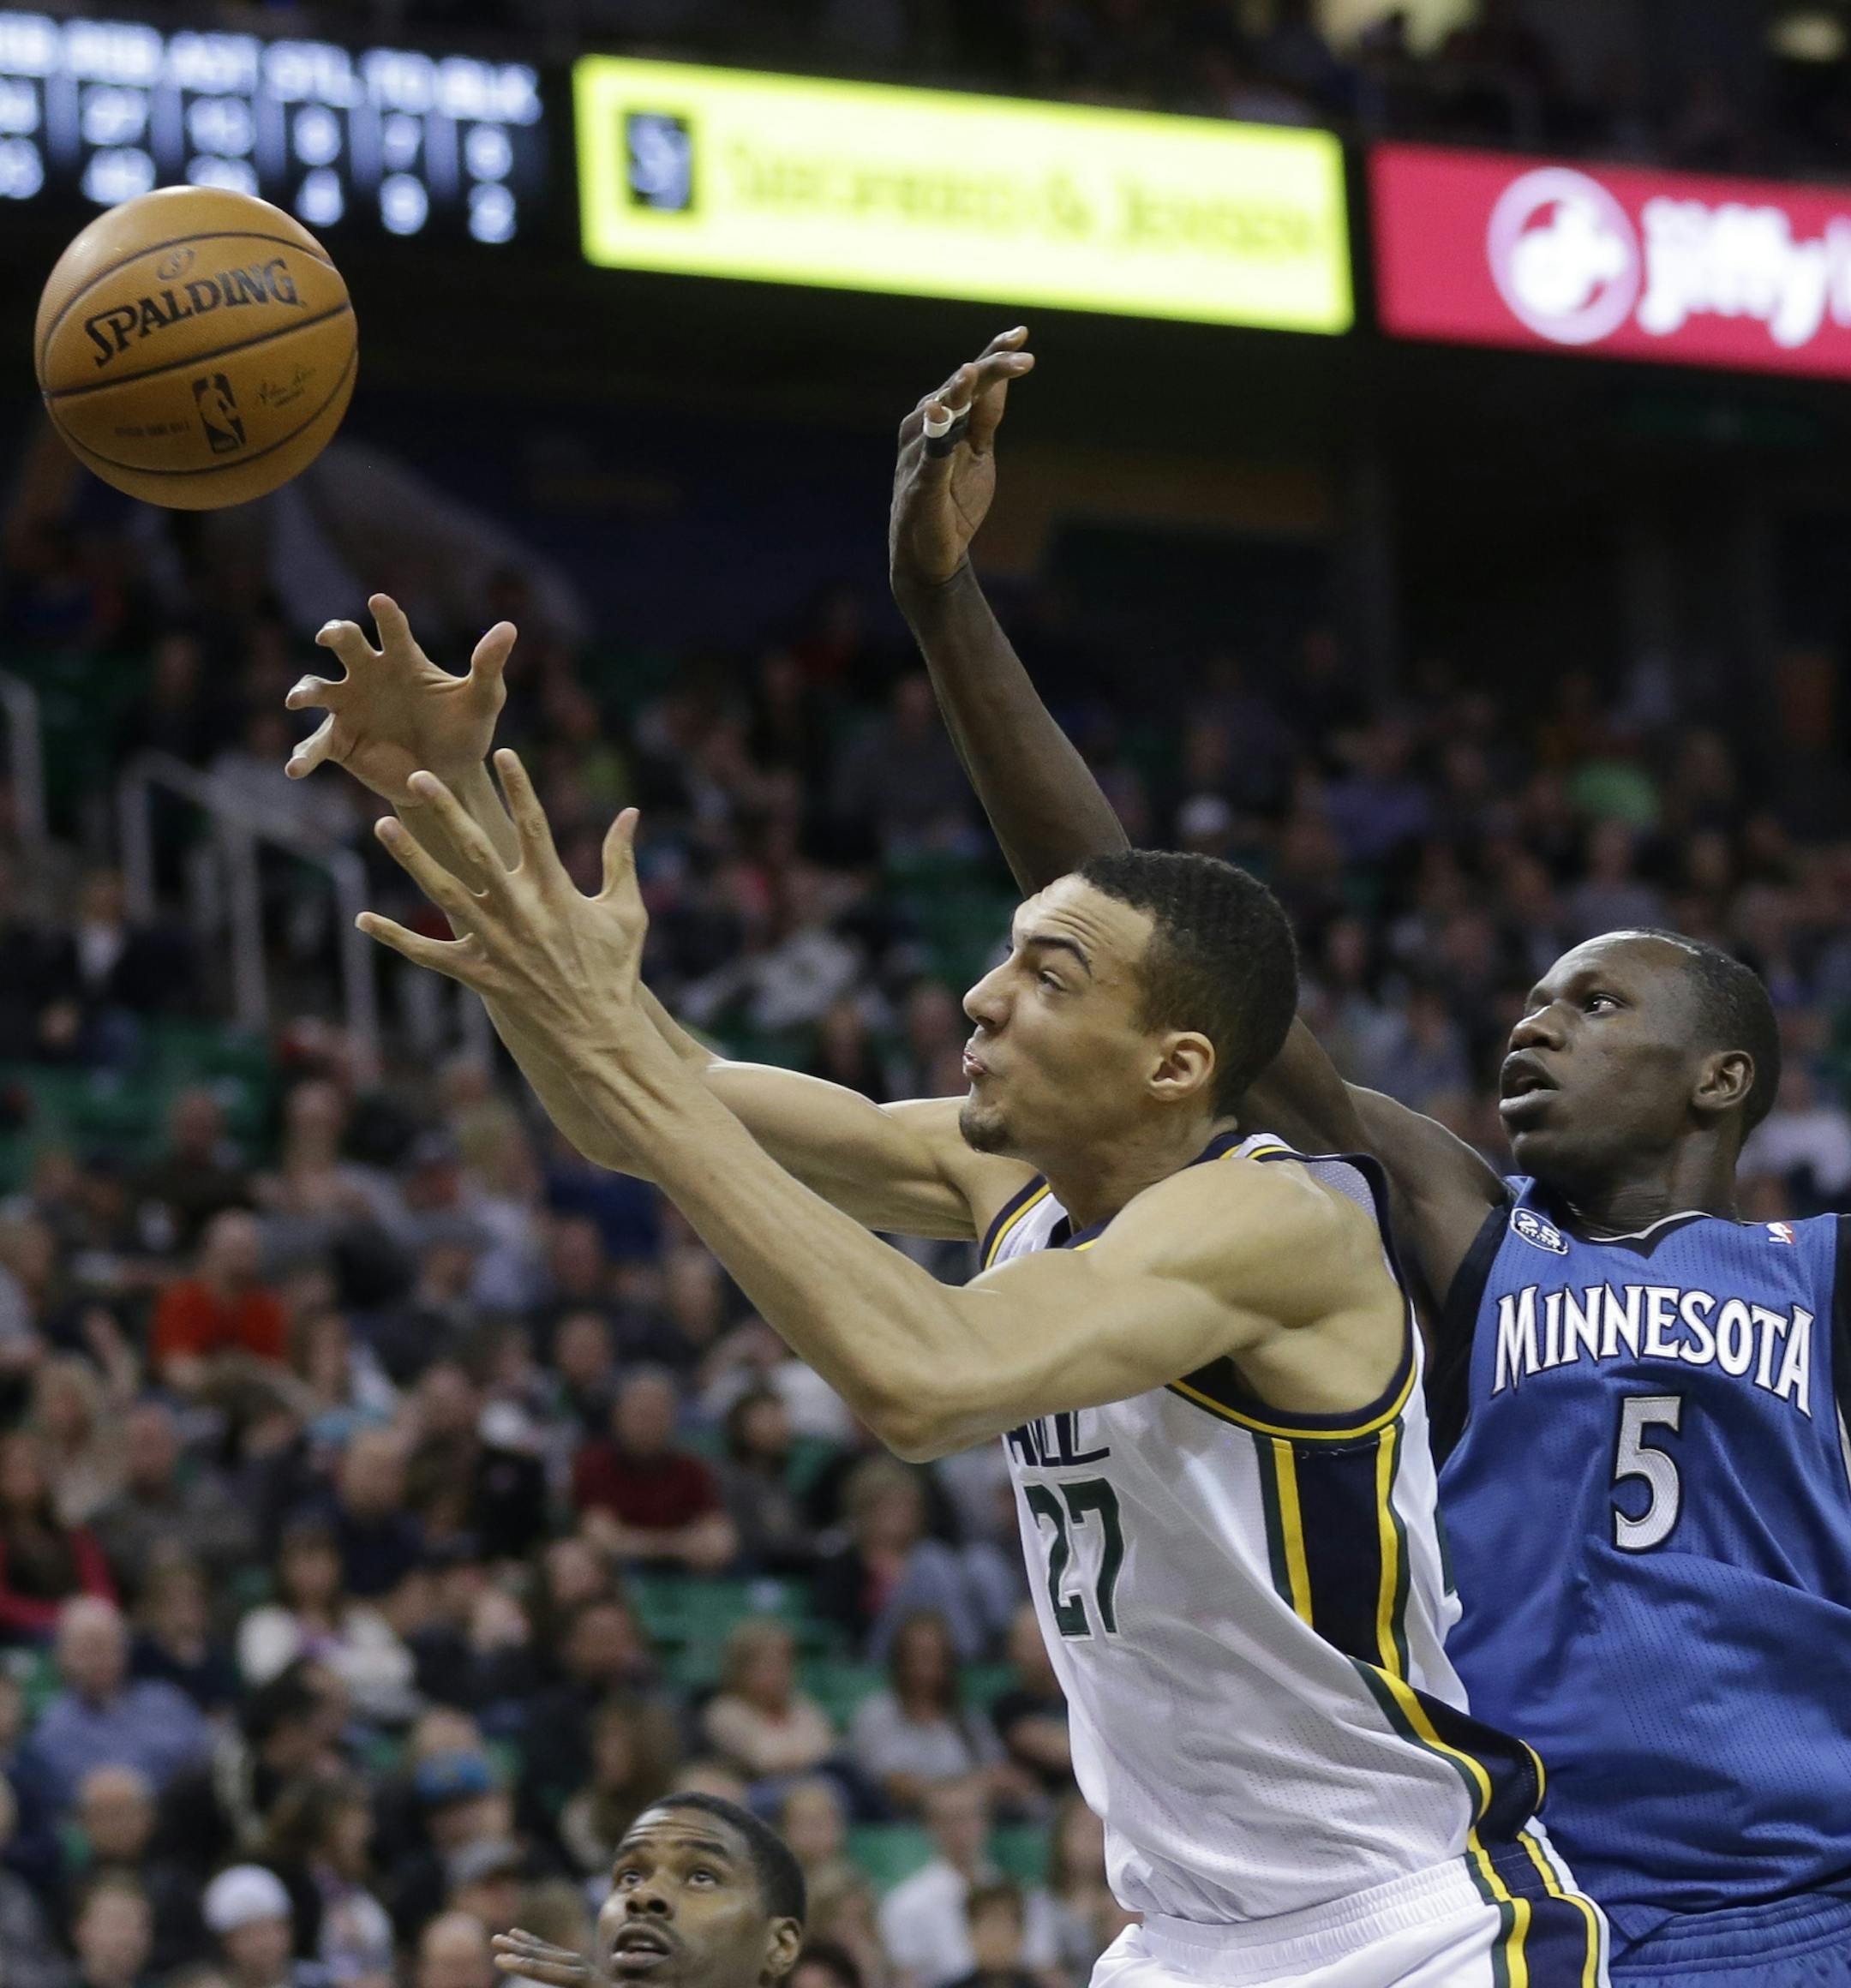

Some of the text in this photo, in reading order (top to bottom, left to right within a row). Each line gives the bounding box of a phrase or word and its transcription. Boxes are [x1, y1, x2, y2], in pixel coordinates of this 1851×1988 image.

[83, 258, 300, 368] SPALDING
[1491, 1280, 1814, 1418] MINNESOTA
[1612, 1394, 1682, 1550] 5
[1022, 1476, 1125, 1638] 27
